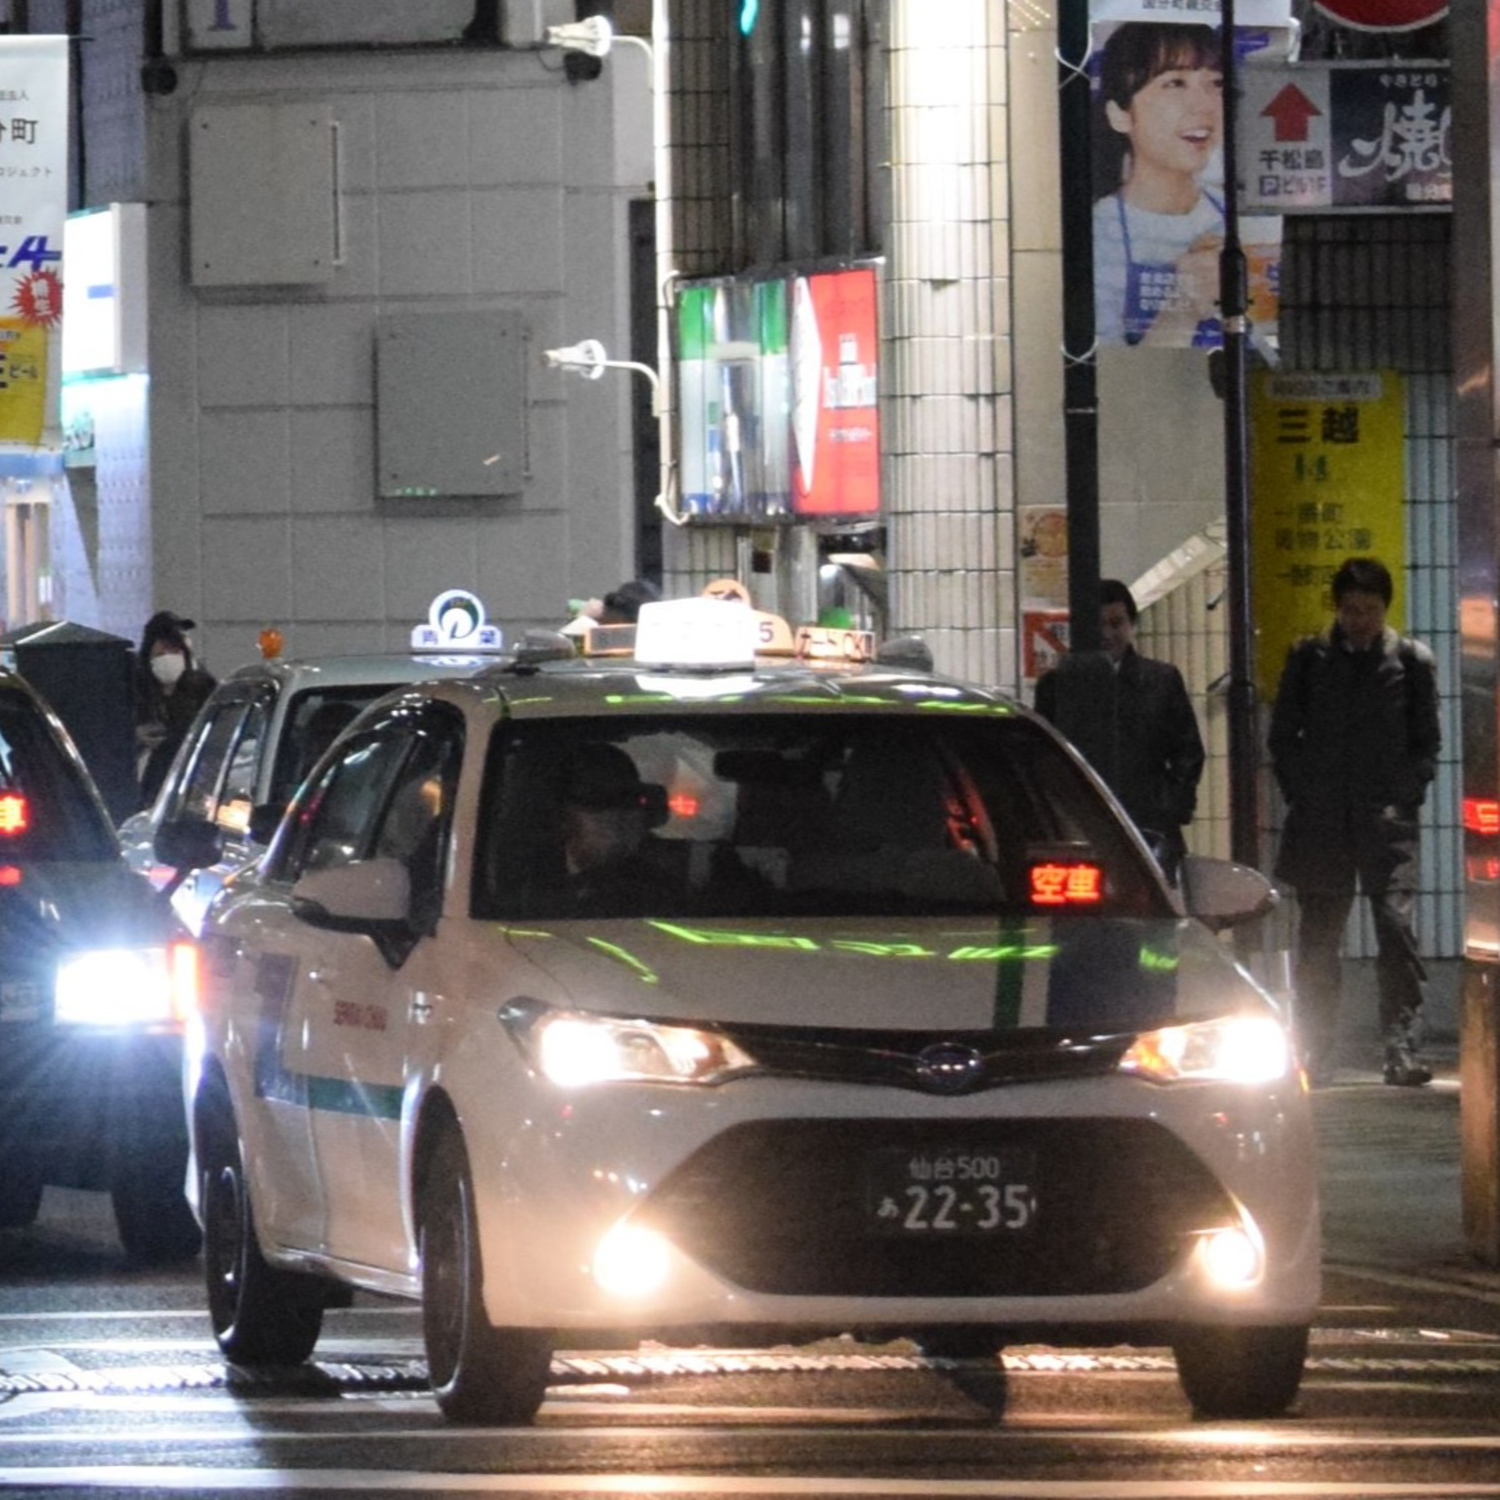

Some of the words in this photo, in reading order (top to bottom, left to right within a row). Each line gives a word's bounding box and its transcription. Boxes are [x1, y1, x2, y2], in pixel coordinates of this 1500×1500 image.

[1030, 863, 1103, 904] 空車
[909, 1155, 999, 1180] 仙台500
[904, 1184, 1029, 1230] 22-35
